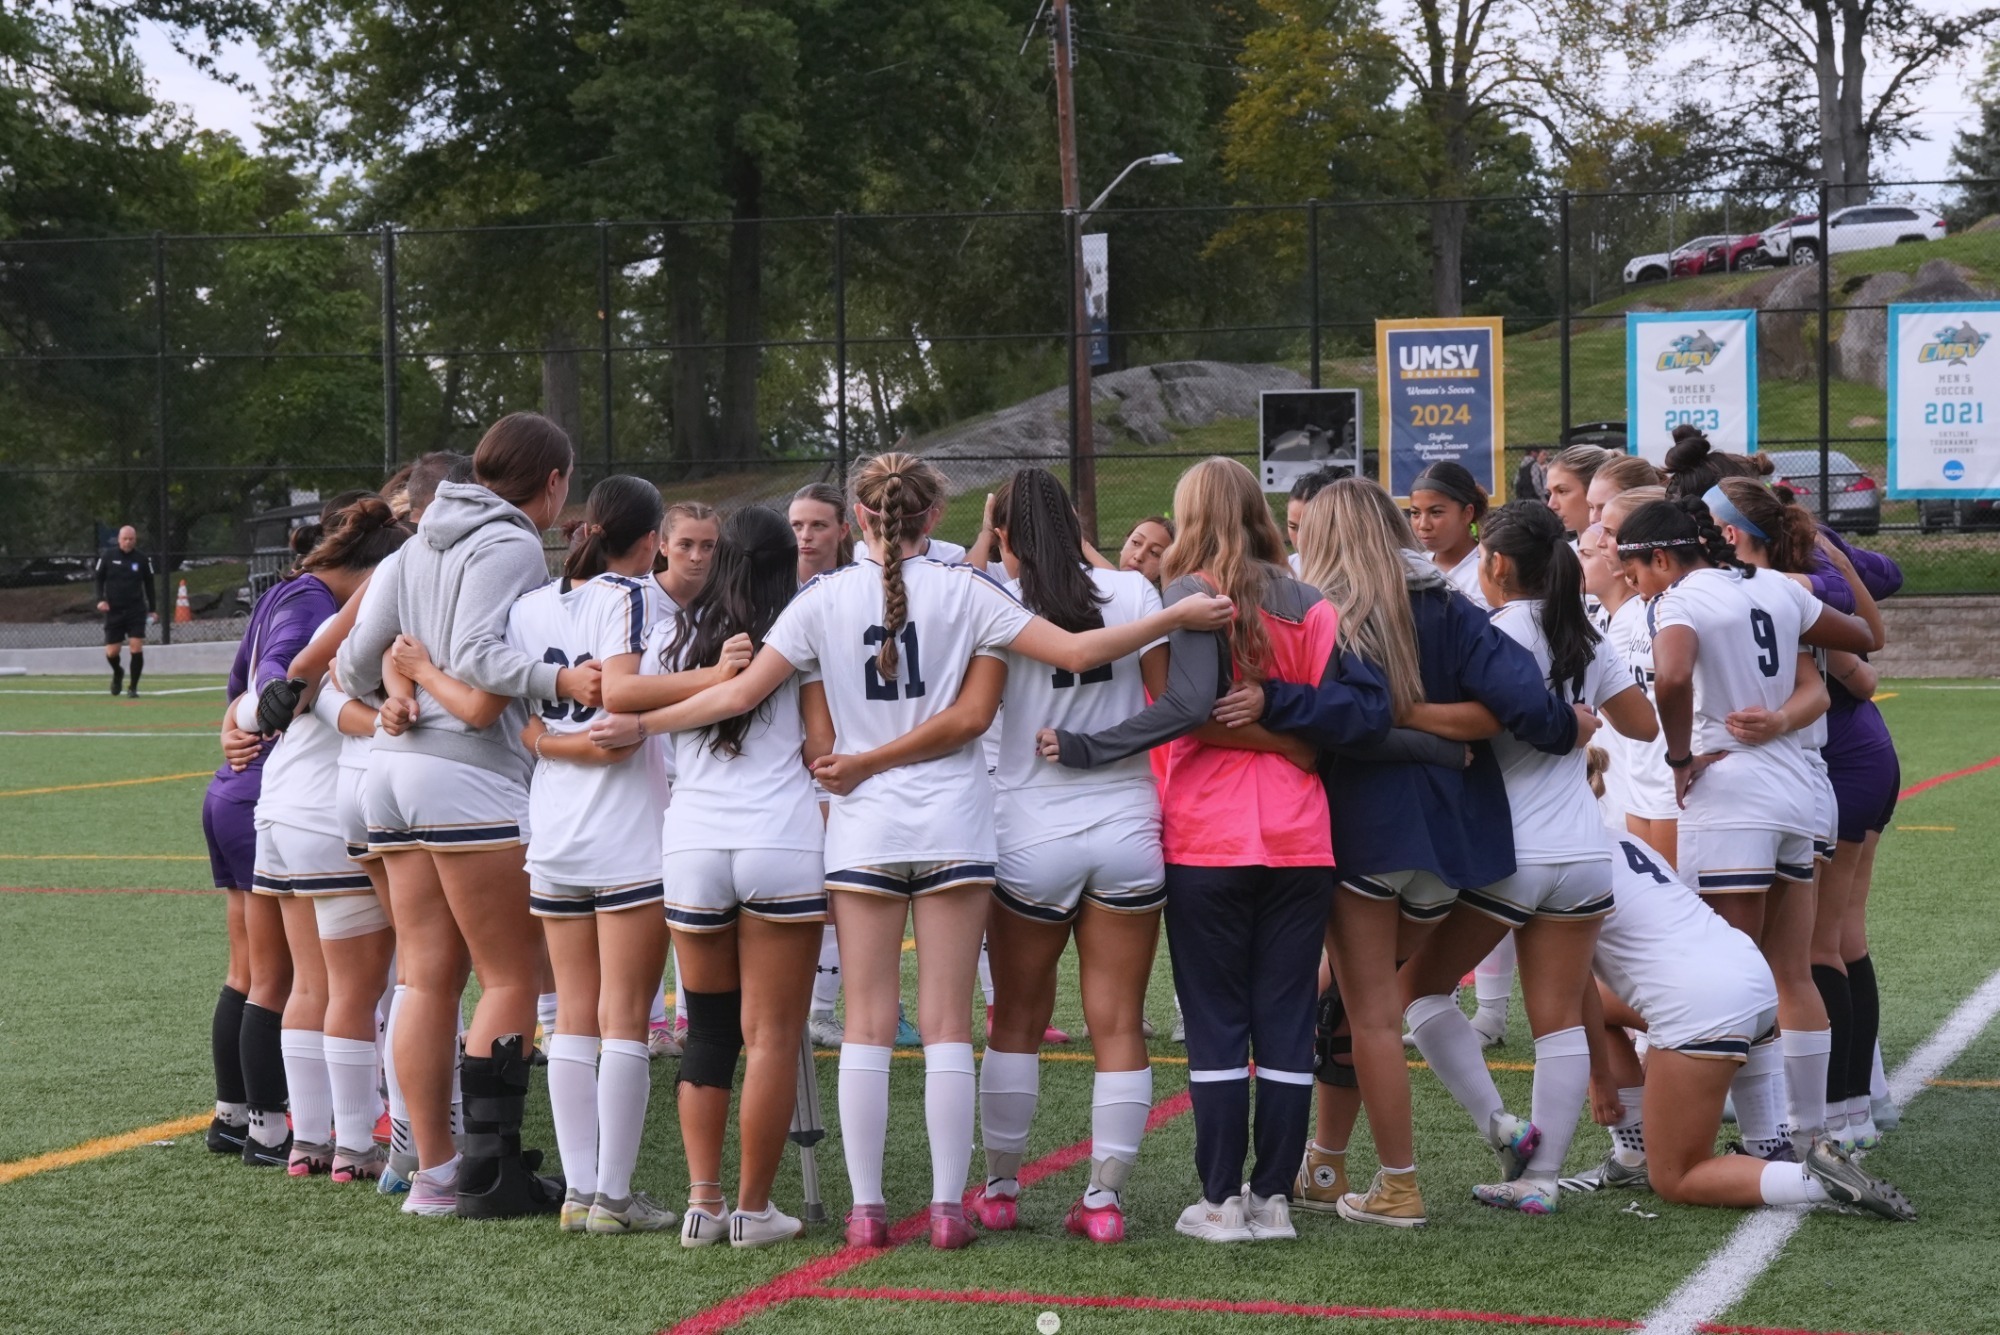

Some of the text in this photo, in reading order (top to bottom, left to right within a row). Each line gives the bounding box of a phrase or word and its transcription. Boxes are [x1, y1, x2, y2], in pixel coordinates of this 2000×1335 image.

[1399, 344, 1479, 370] UMSV
[1656, 351, 1720, 371] CMSV
[1918, 343, 1985, 363] CMSV
[1407, 370, 1471, 378] DOLPHINS
[1938, 374, 1971, 383] MEN'S
[1406, 385, 1475, 395] Women's Soccer
[1668, 384, 1716, 394] WOMEN'S
[1934, 386, 1974, 396] SOCCER
[1672, 395, 1712, 405] SOCCER
[1410, 404, 1472, 427] 2024
[1665, 409, 1719, 431] 2023
[1925, 402, 1984, 424] 2021
[1750, 608, 1780, 678] 9
[863, 620, 926, 701] 21
[1618, 841, 1672, 884] 4
